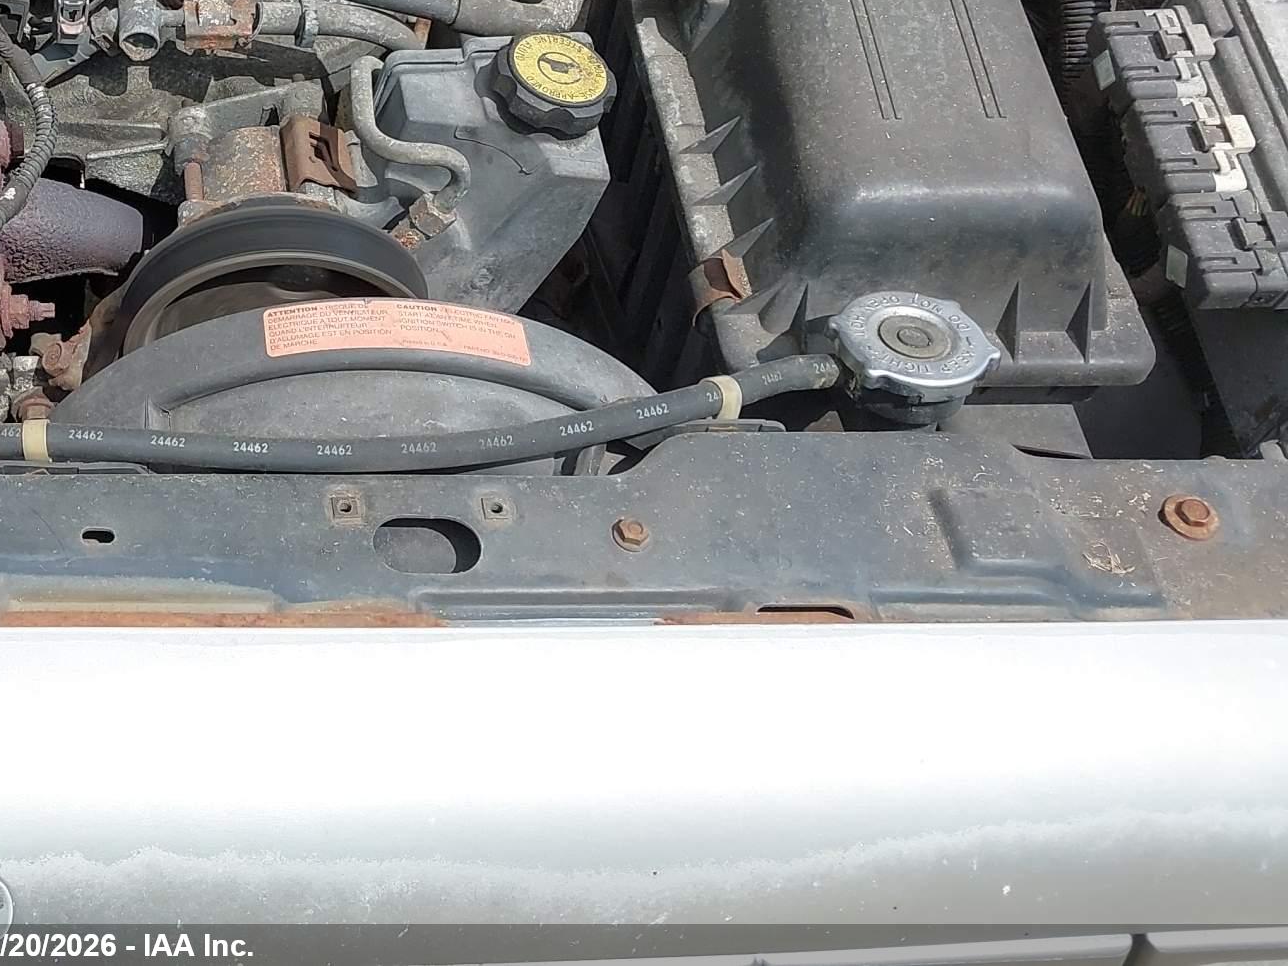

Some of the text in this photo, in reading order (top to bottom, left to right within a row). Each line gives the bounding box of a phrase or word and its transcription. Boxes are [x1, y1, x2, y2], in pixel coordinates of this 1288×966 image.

[268, 306, 318, 318] ATTENTION
[396, 303, 438, 312] CAUTION
[636, 402, 670, 420] 24462
[559, 420, 595, 437] 24462
[68, 429, 104, 442] 24462
[150, 435, 186, 448] 24462
[232, 441, 269, 454] 24462
[401, 442, 437, 454] 24462
[478, 434, 514, 451] 24462
[316, 444, 353, 456] 24462
